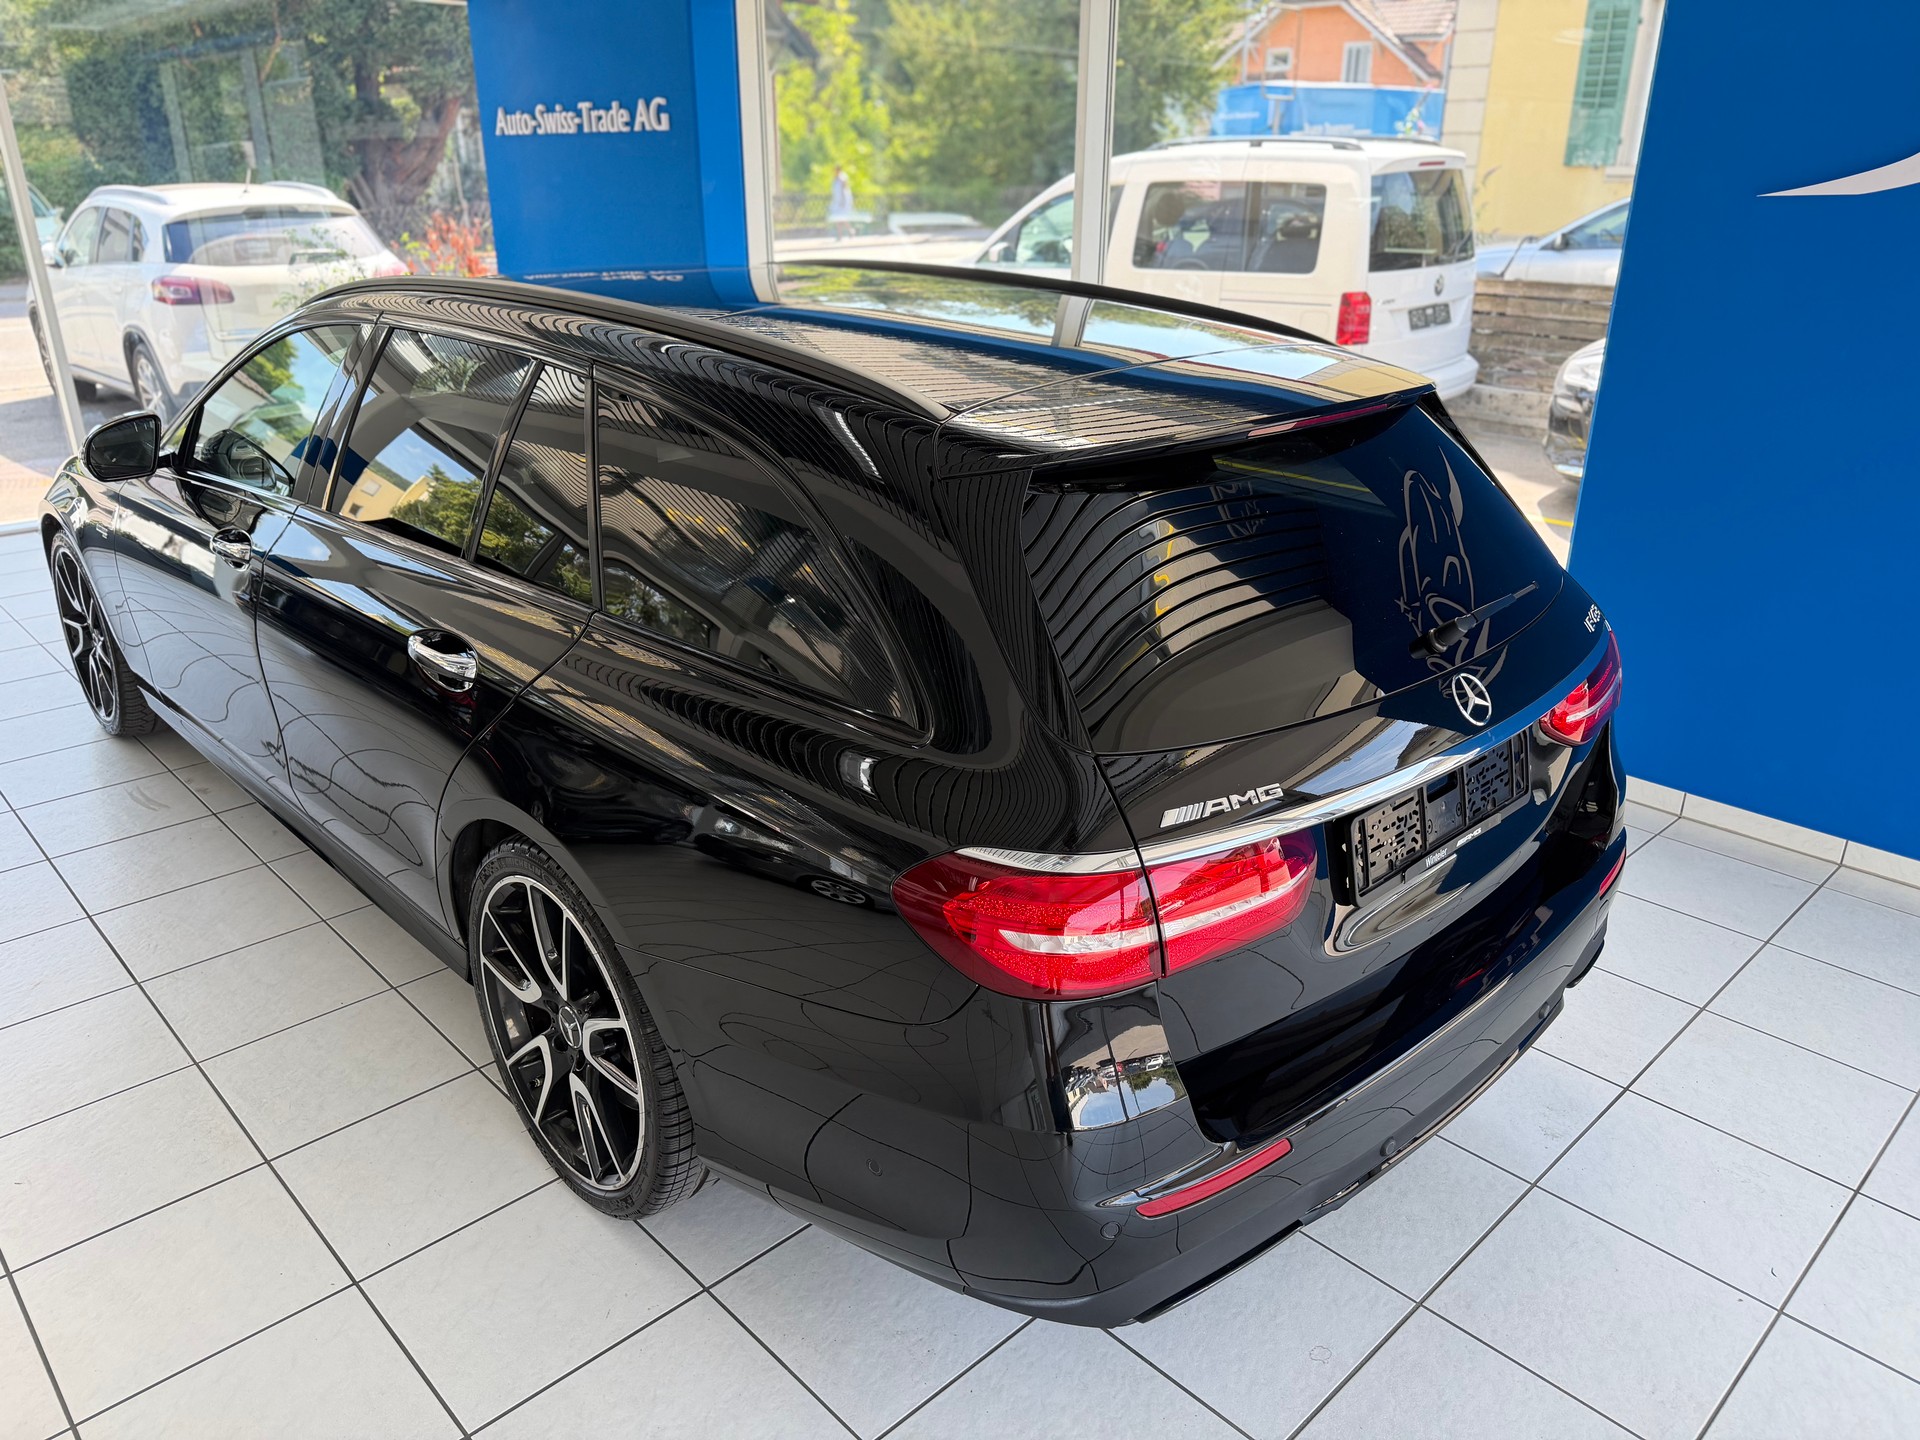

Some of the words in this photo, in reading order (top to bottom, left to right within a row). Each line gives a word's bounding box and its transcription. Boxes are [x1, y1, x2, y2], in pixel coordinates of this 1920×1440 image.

[495, 101, 631, 136] Auto-Swiss-Trade
[633, 96, 670, 132] AG
[1201, 782, 1284, 818] AMG
